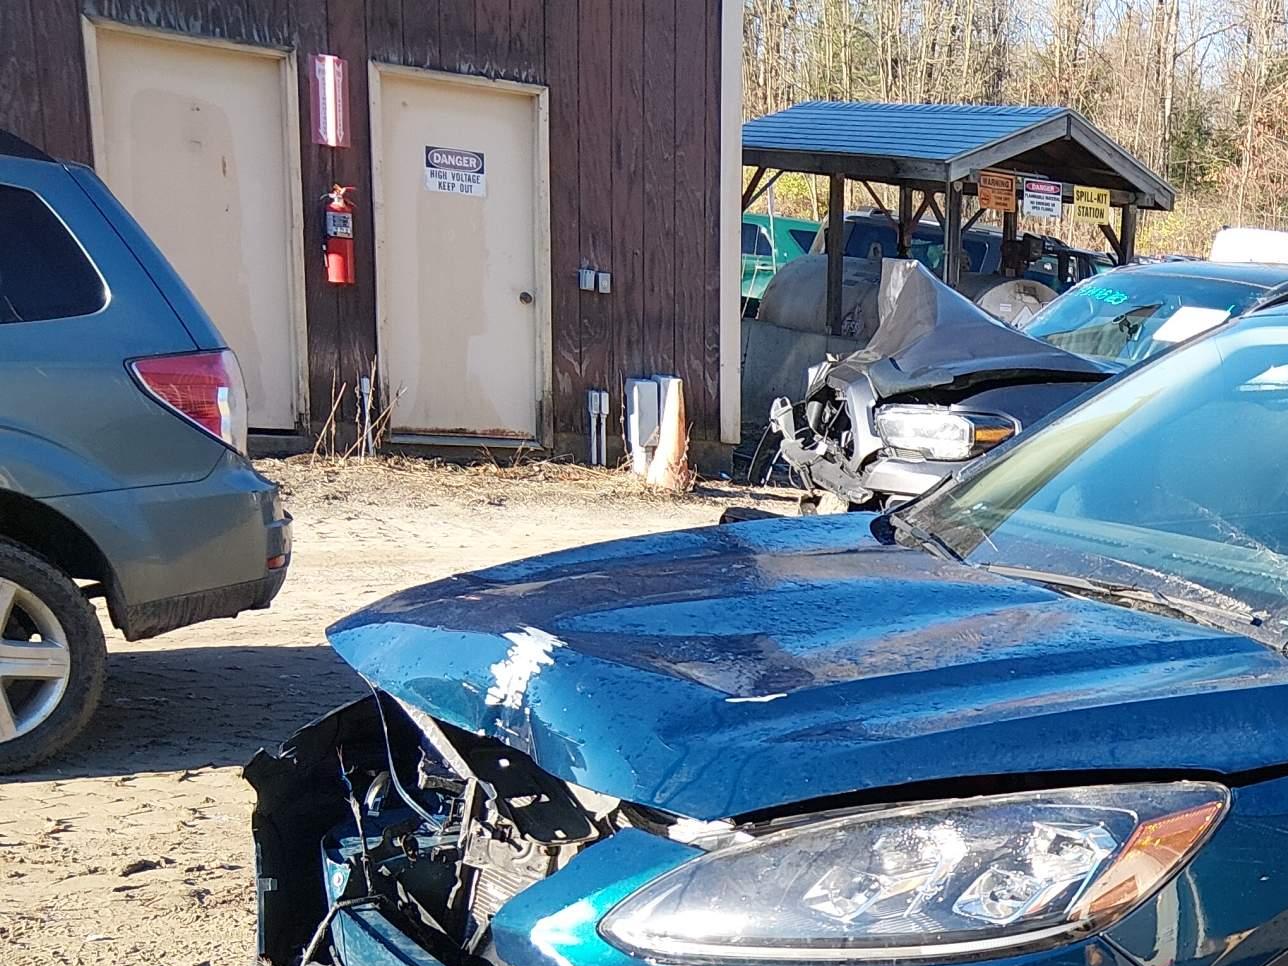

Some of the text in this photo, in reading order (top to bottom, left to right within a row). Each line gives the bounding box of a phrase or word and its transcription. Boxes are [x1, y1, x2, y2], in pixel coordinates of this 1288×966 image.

[433, 152, 477, 168] DANGER
[430, 169, 481, 184] HIGH VOLTAGE
[983, 176, 1009, 188] WARNING
[438, 181, 473, 194] KEEP OUT
[1031, 183, 1055, 192] DANGER
[1075, 190, 1108, 204] SPILL-KIT
[1077, 206, 1105, 219] STATION
